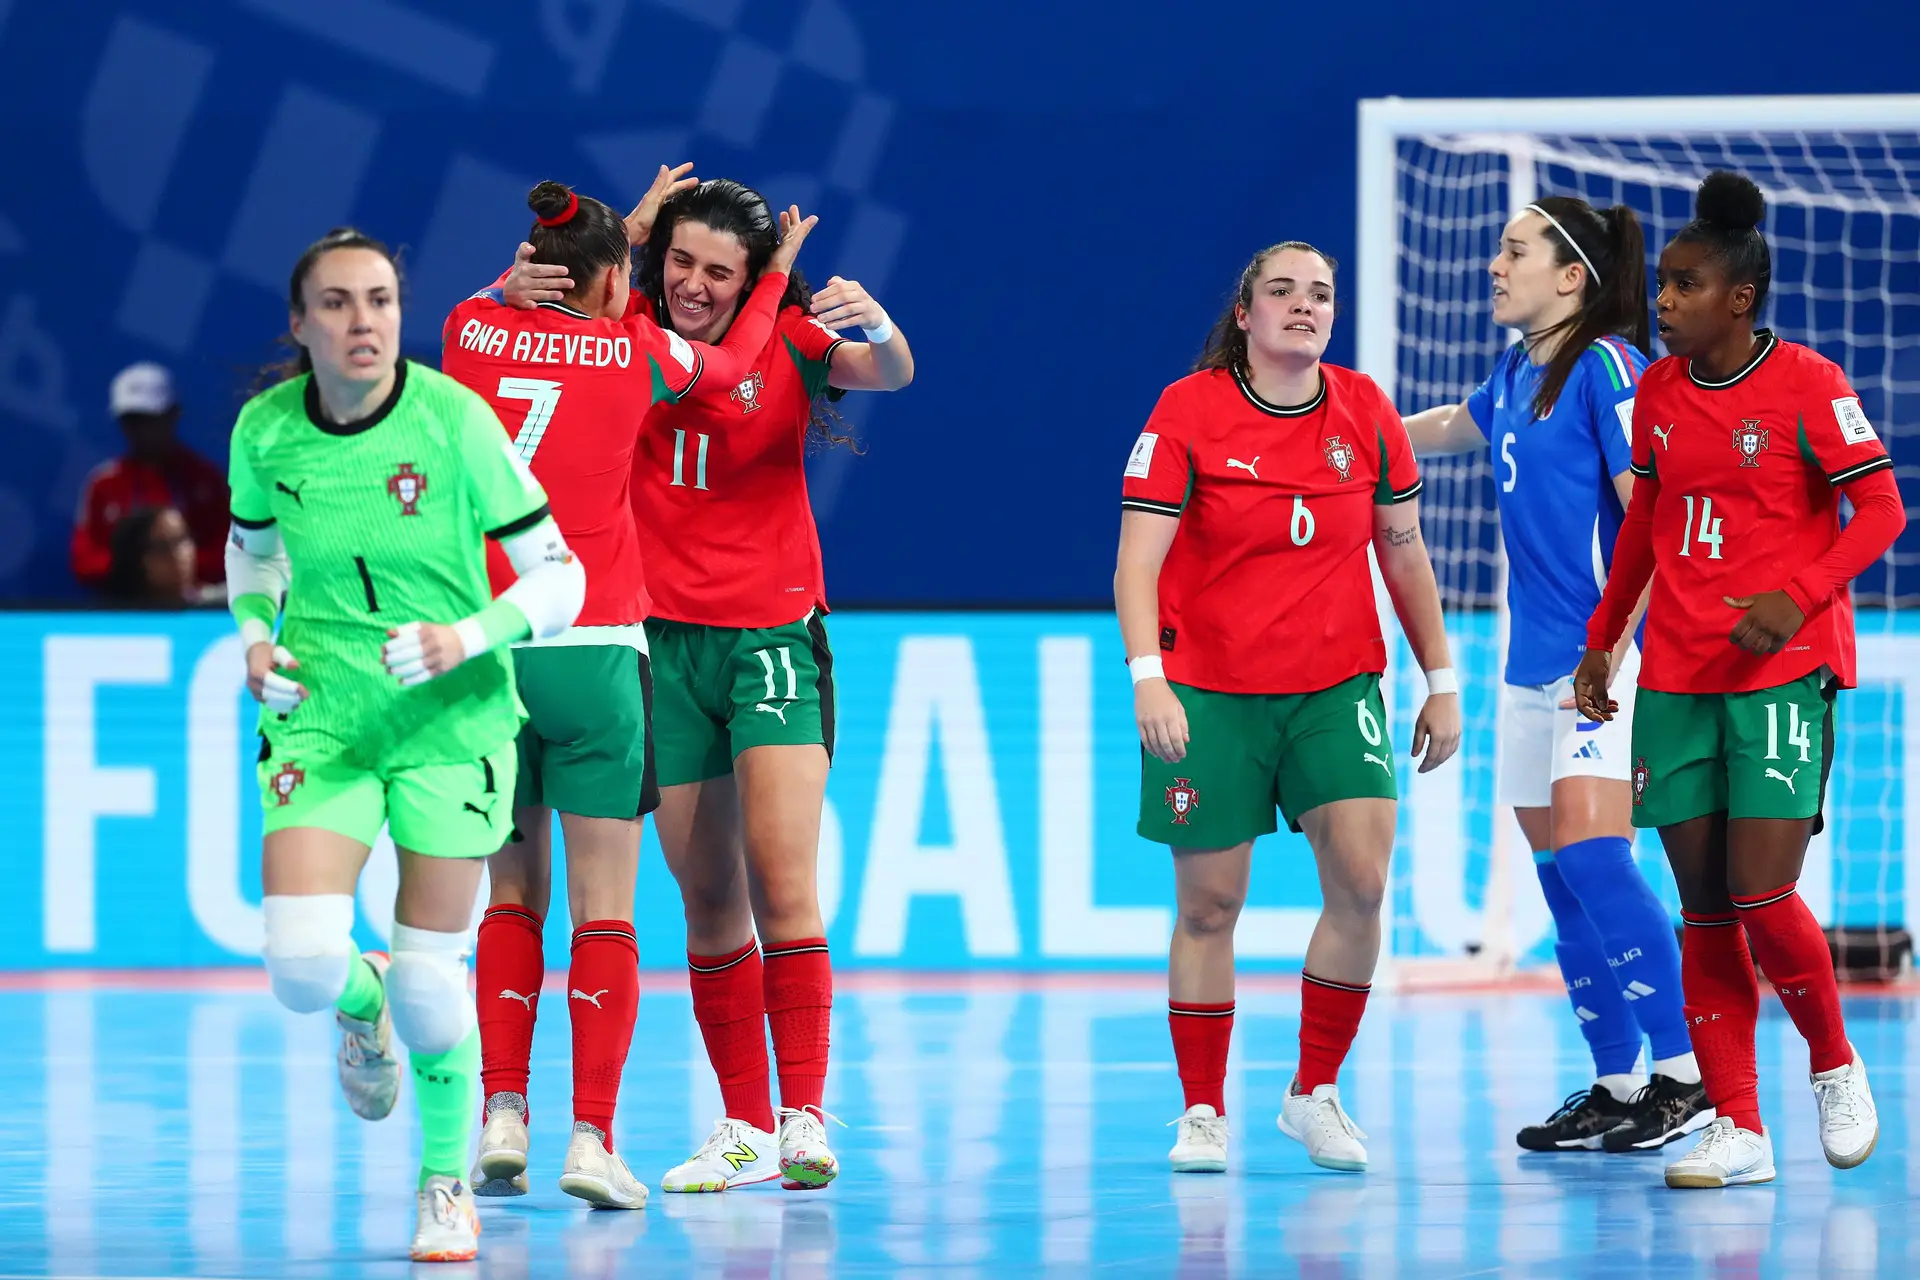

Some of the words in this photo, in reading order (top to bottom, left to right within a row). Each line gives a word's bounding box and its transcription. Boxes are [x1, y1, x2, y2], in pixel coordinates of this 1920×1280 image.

[459, 318, 509, 357] ANA
[512, 331, 632, 369] AZEVEDO
[496, 376, 564, 468] 7
[670, 428, 710, 491] 11
[1501, 432, 1517, 493] 5
[1290, 494, 1315, 546] 6
[1678, 495, 1724, 560] 14
[353, 556, 381, 613] 1
[753, 646, 800, 700] 11
[1354, 697, 1382, 747] 6
[1764, 702, 1811, 763] 14
[478, 756, 497, 793] 1
